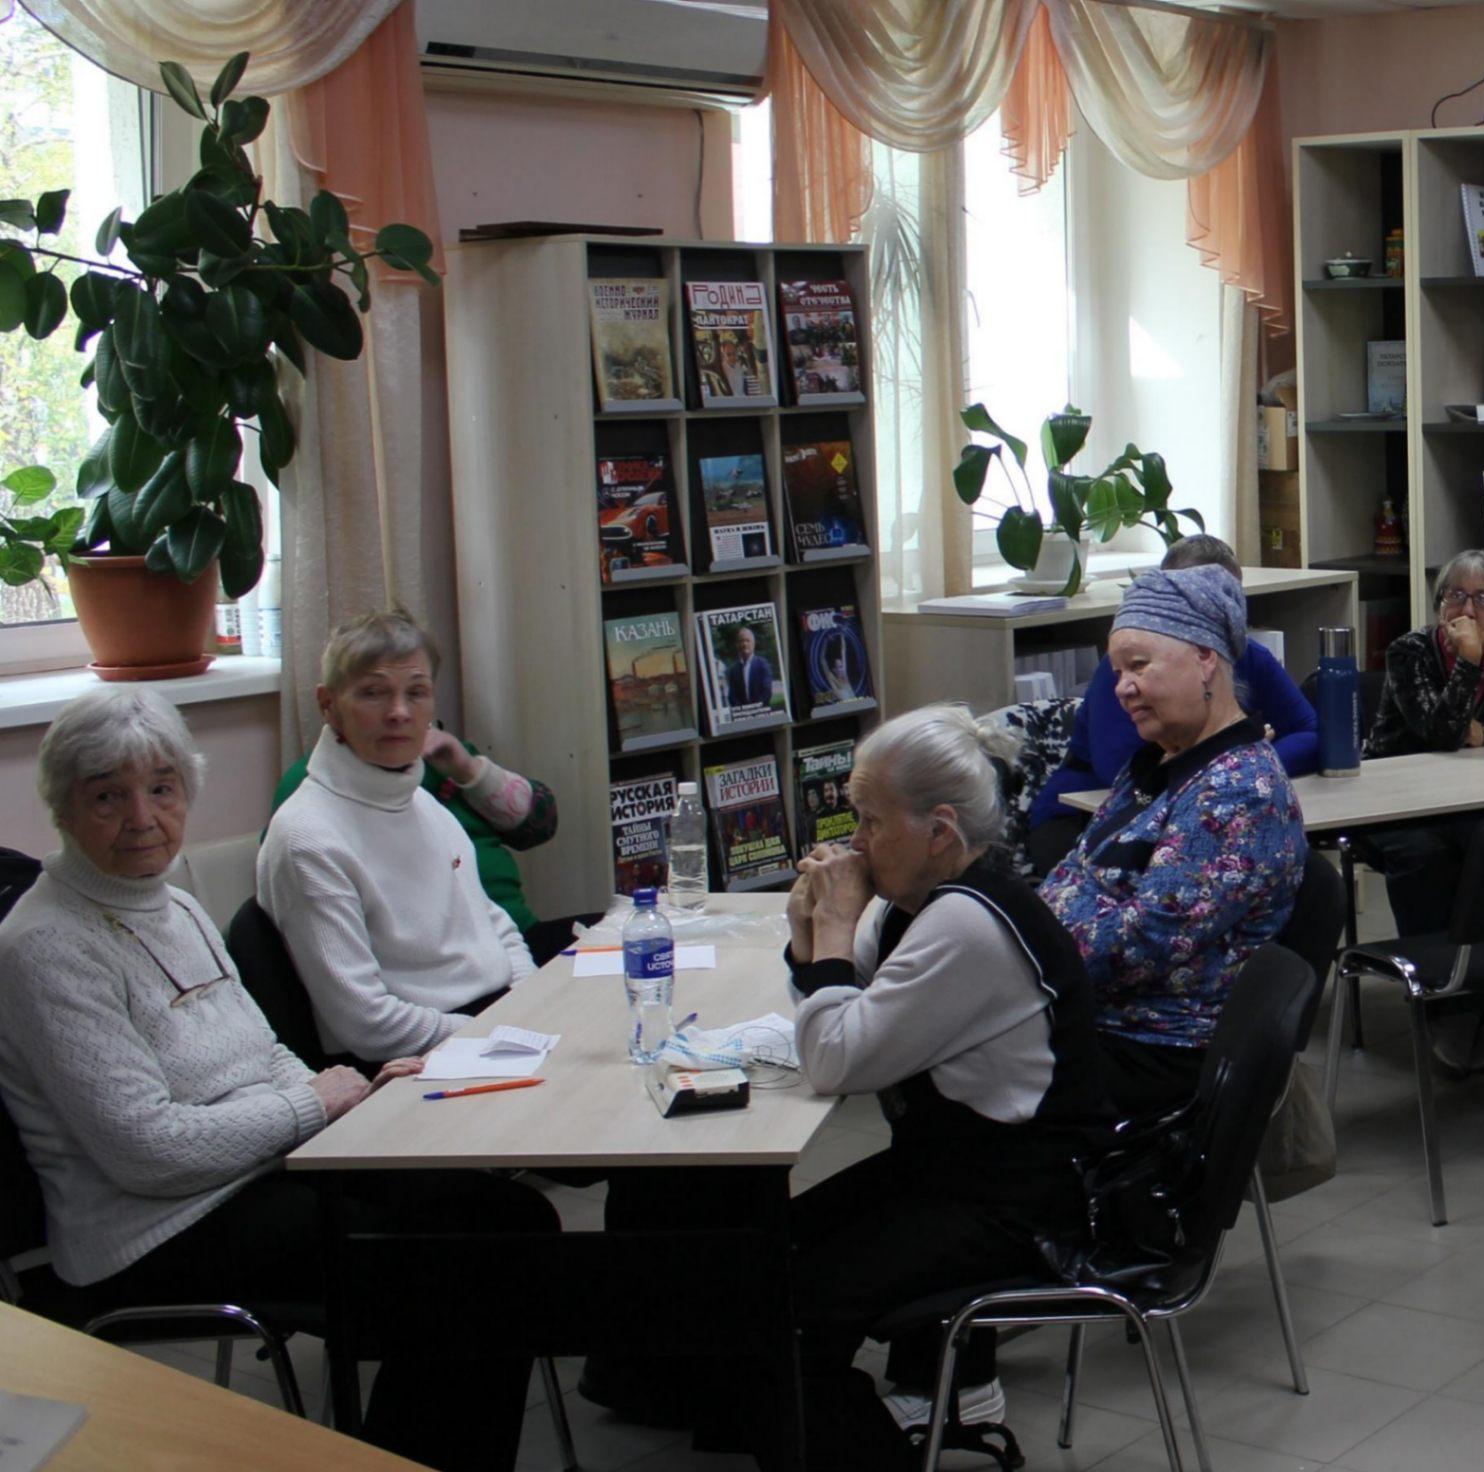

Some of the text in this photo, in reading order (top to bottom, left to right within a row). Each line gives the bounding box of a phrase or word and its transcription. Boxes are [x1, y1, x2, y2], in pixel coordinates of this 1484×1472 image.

[711, 608, 773, 624] ТАТАРСТАН
[615, 620, 676, 641] КАЗАНЬ
[720, 764, 772, 786] ЗАГАДКИ
[610, 780, 673, 806] РУССКАЯ
[720, 778, 775, 801] ИСТОРИИ
[611, 797, 675, 821] ИСТОРИЯ
